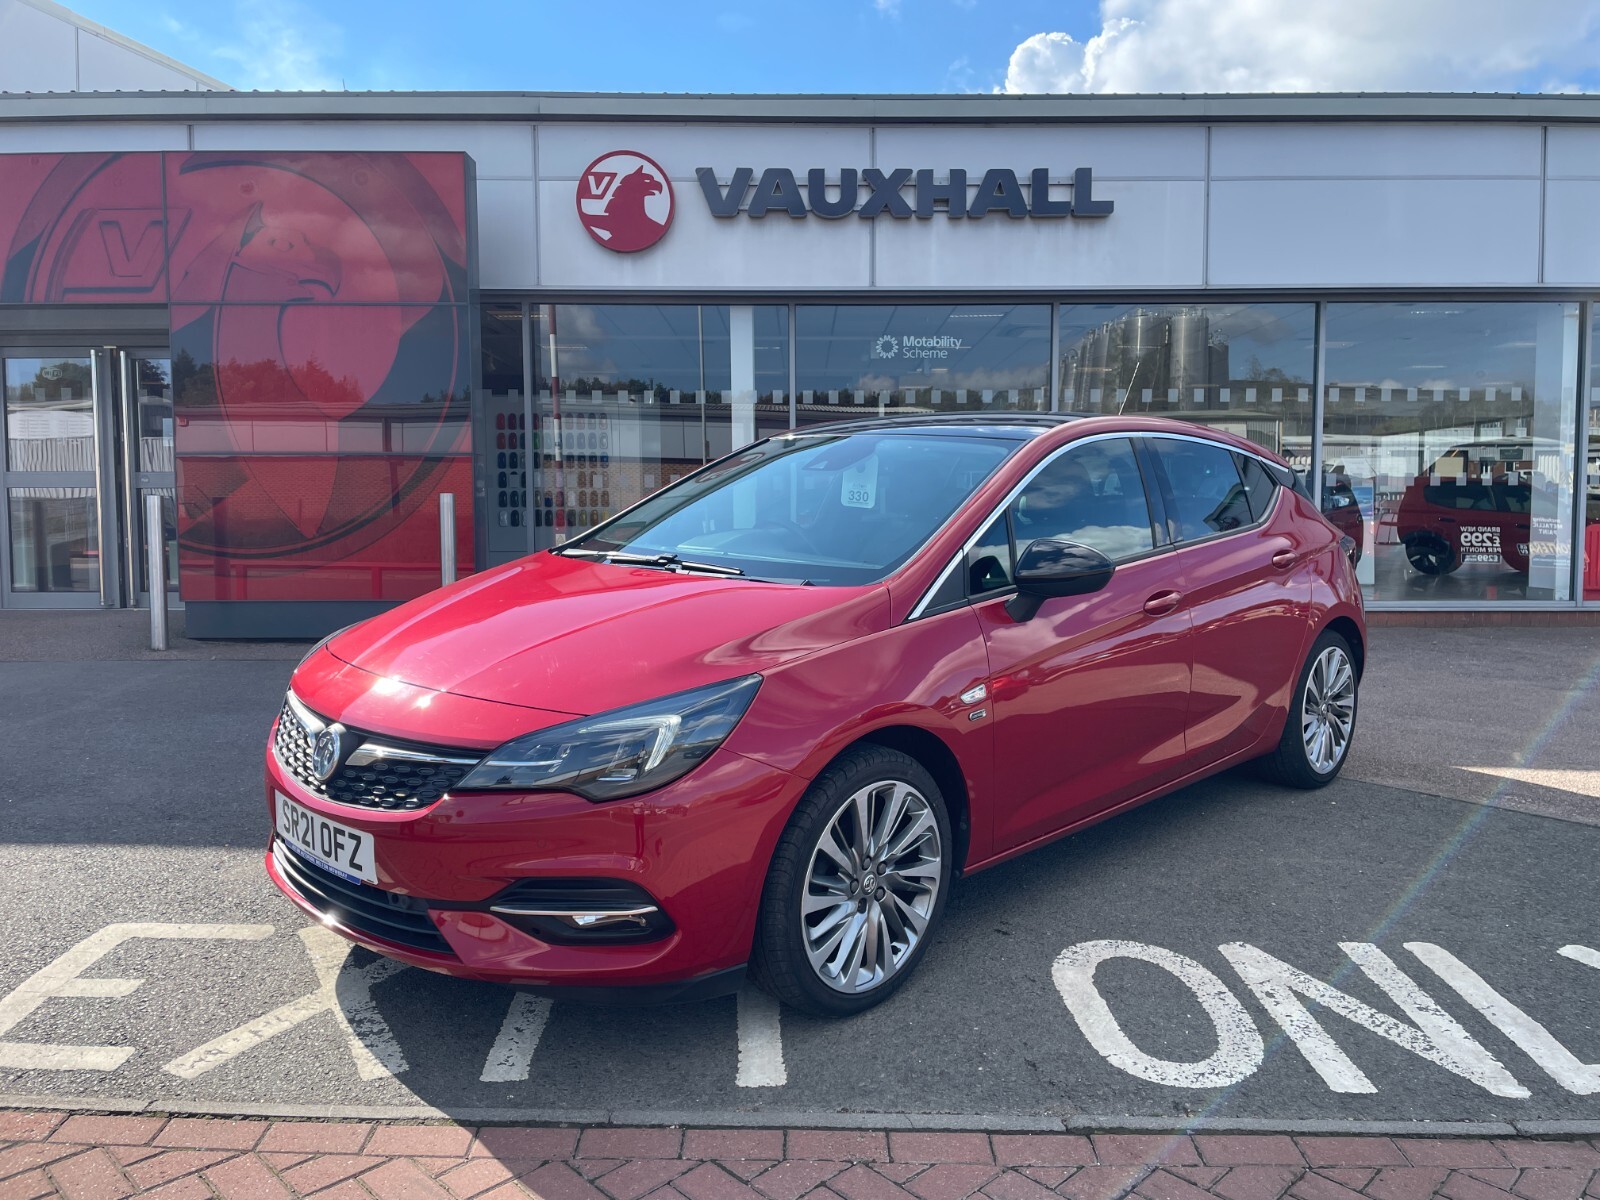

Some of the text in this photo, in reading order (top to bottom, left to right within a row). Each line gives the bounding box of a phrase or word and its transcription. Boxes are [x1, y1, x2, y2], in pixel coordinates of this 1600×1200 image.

[587, 175, 611, 195] V
[695, 167, 1115, 219] VAUXHALL
[903, 335, 962, 350] Motability
[903, 347, 948, 359] Scheme
[848, 490, 869, 502] 330
[282, 799, 316, 851] SR21
[320, 821, 363, 872] OFZ
